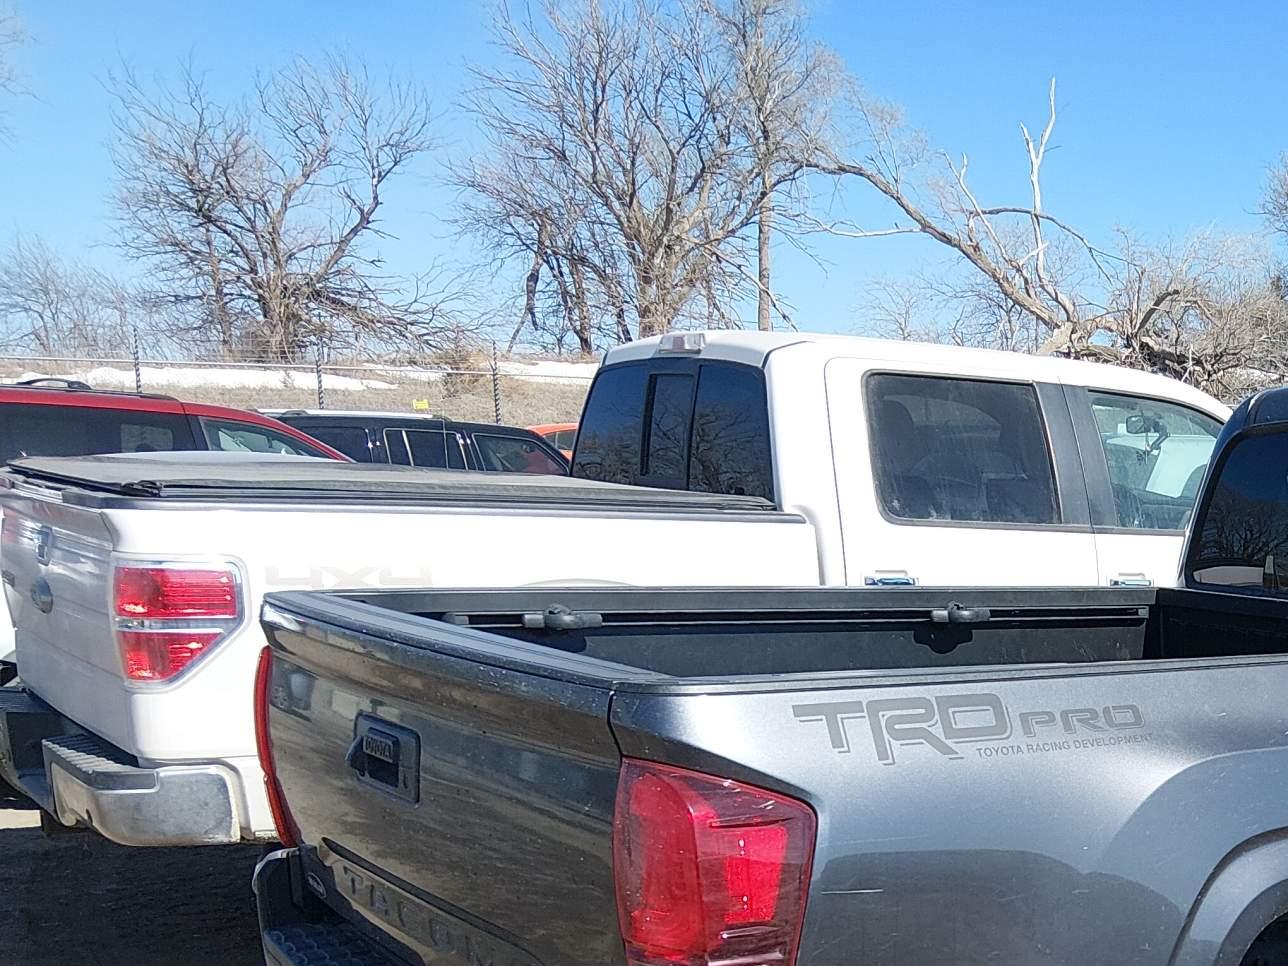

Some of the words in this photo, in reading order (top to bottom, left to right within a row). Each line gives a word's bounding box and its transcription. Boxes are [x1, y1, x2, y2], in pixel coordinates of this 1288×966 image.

[792, 692, 1012, 767] TRD
[1020, 704, 1148, 739] PRO
[976, 744, 1025, 760] TOYOTA
[1026, 739, 1072, 756] RACING
[1073, 732, 1155, 752] DEVELOPMENT
